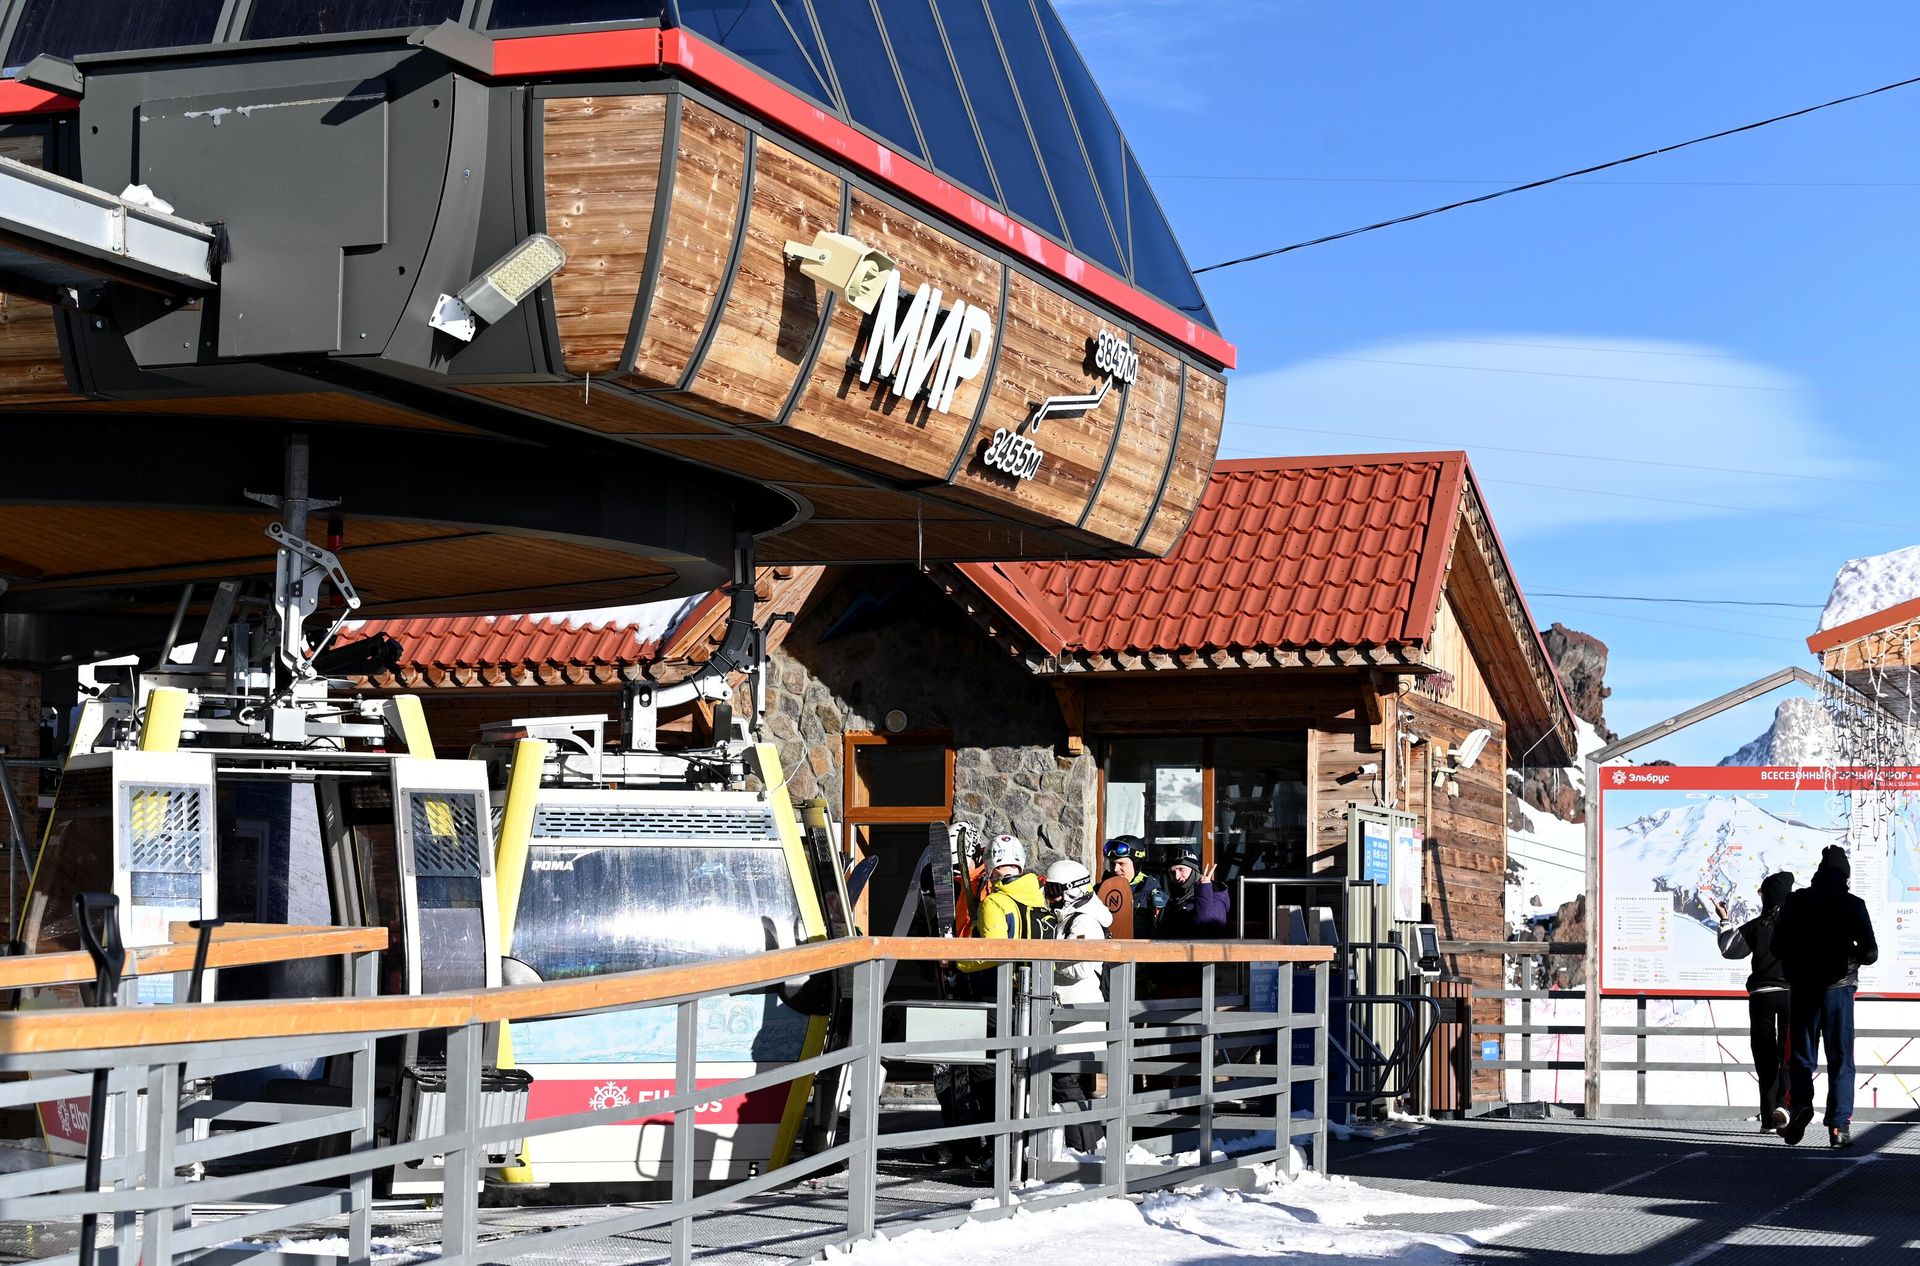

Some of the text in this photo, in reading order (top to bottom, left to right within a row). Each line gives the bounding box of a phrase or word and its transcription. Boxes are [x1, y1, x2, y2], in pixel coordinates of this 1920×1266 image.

[859, 268, 991, 414] МИР
[1628, 773, 1670, 785] Эльбрус
[1761, 768, 1831, 780] ВСЕСЕЗОННЫЙ
[531, 860, 574, 871] POMA
[747, 1162, 759, 1178] 5
